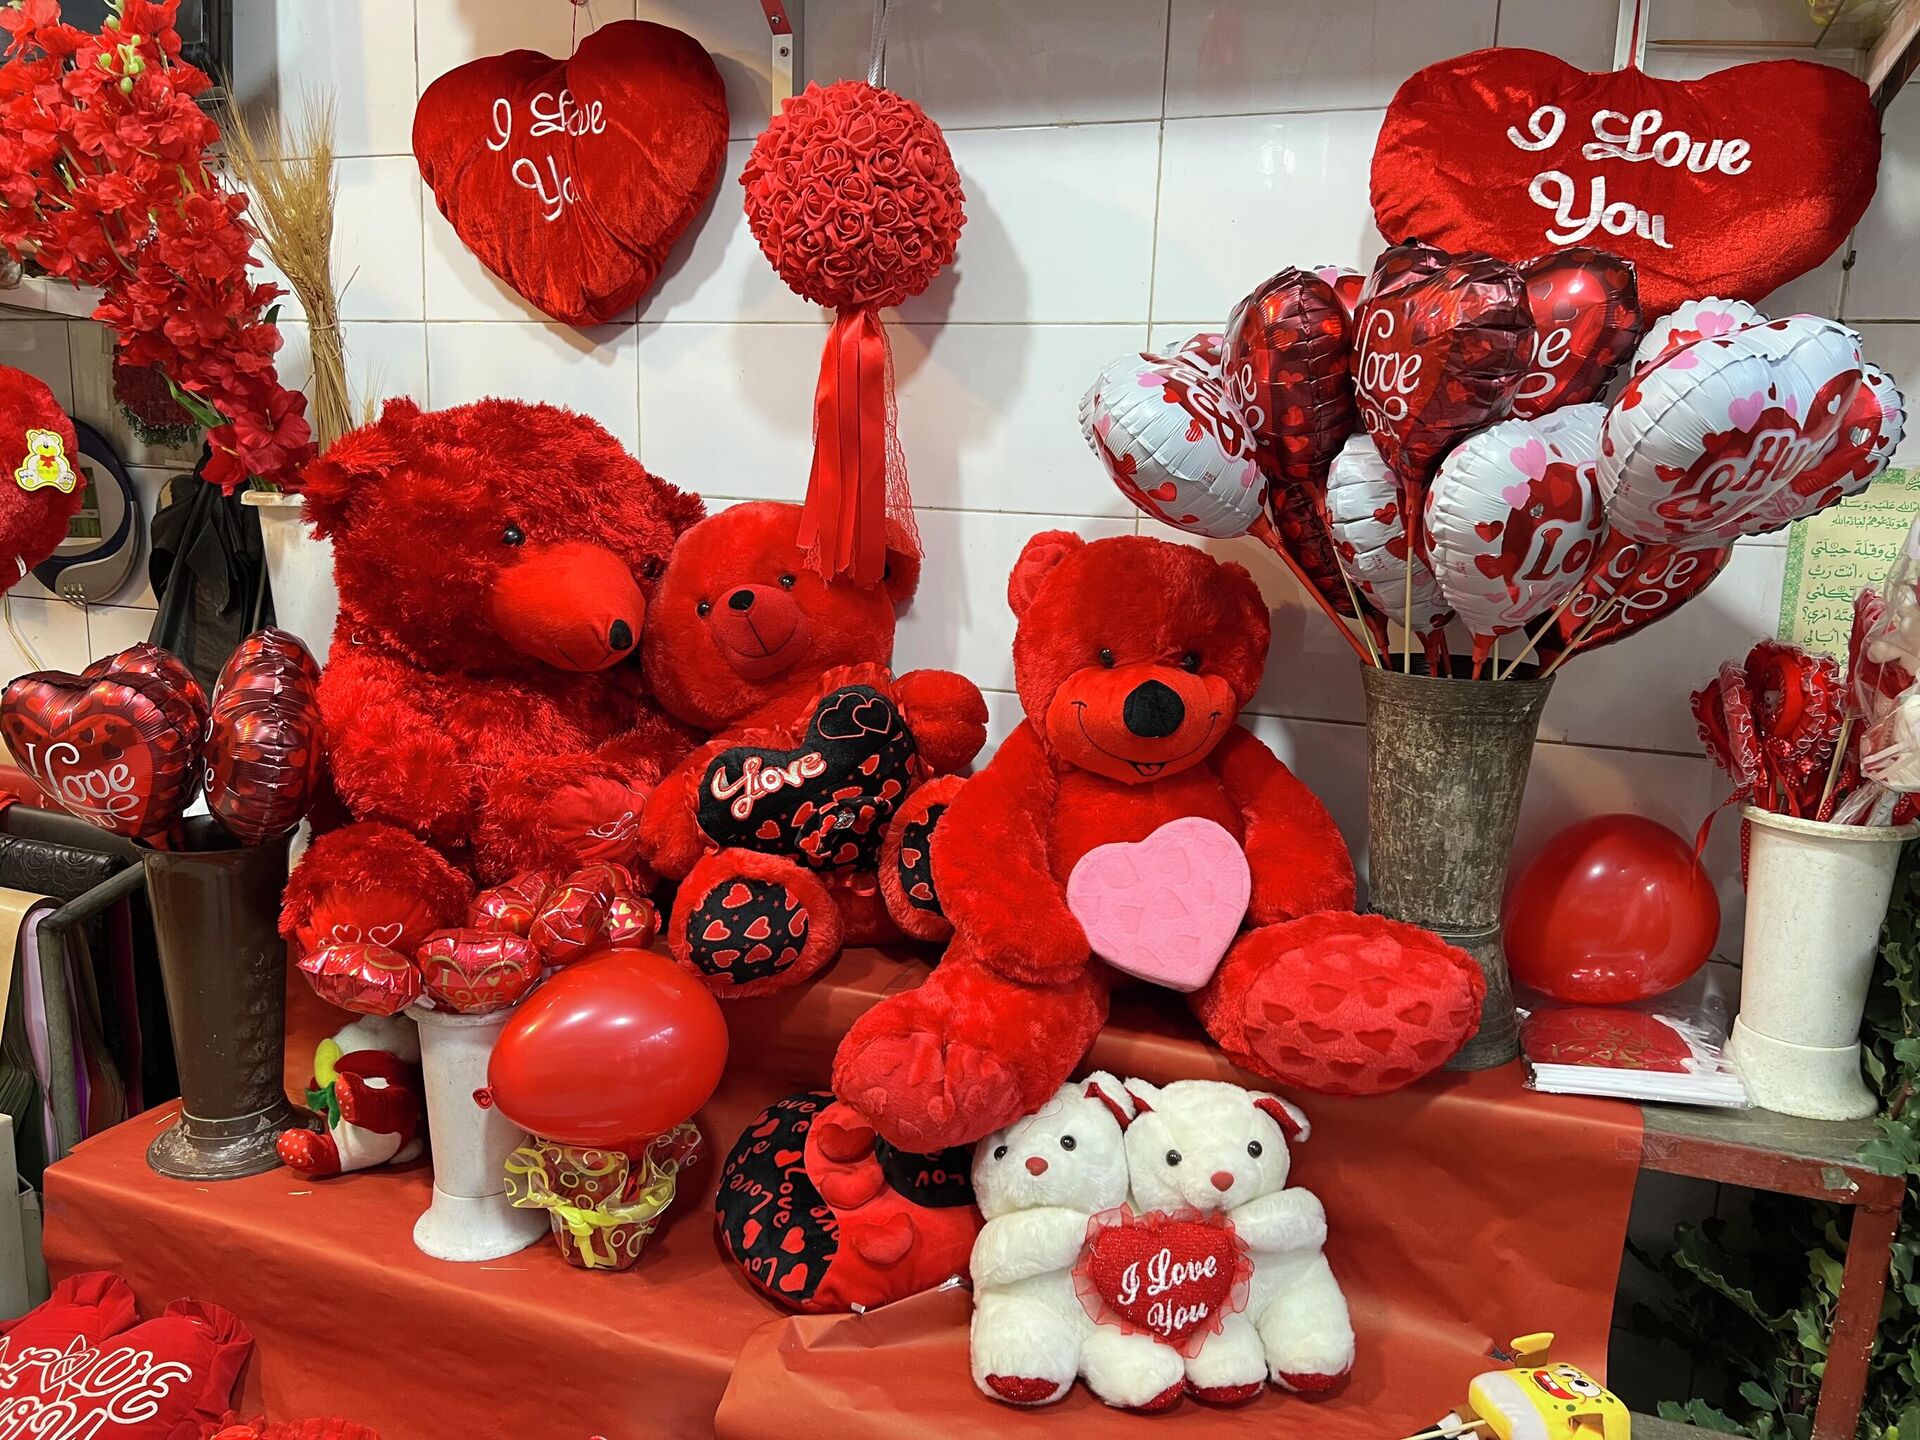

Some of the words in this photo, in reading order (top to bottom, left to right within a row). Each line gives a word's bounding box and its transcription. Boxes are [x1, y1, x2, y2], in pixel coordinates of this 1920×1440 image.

[487, 98, 511, 150] I
[1507, 105, 1566, 151] I
[1582, 109, 1752, 175] Love
[512, 155, 579, 221] Yo
[1528, 170, 1673, 248] You
[1352, 309, 1423, 400] Love
[44, 742, 135, 802] Love
[777, 1099, 817, 1113] ove
[1117, 1262, 1140, 1305] I
[1147, 1248, 1217, 1296] Love
[1147, 1298, 1209, 1336] You
